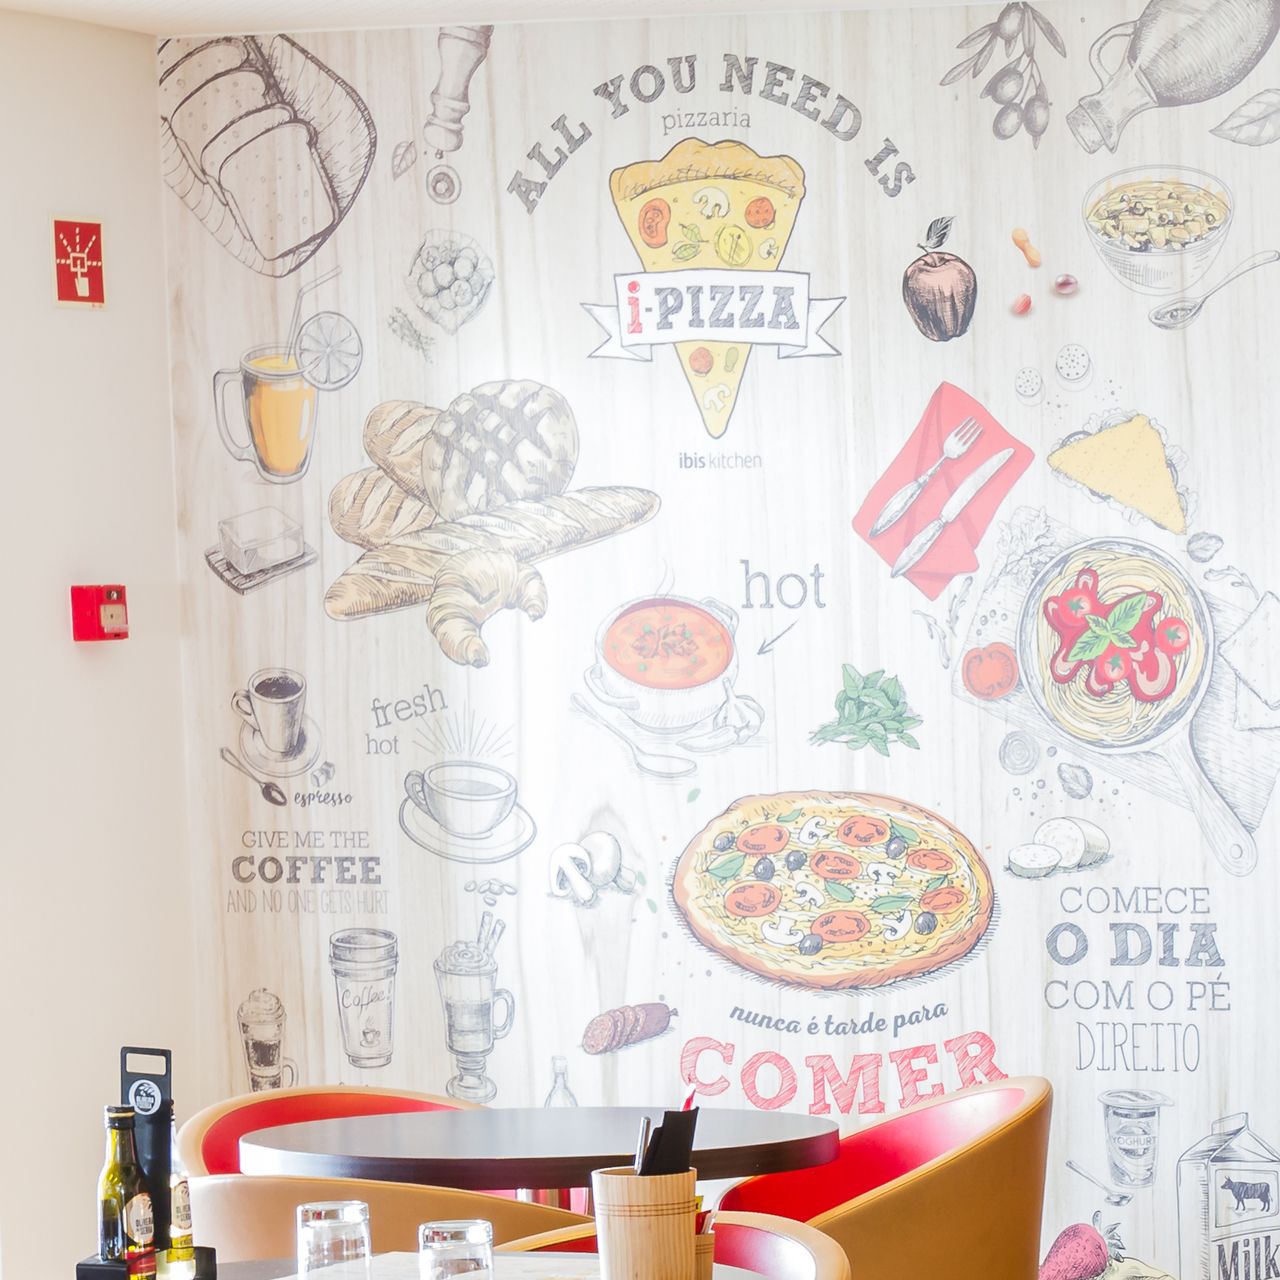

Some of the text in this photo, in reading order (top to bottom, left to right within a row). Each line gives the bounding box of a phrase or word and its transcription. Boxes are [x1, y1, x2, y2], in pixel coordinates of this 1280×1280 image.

[507, 53, 916, 215] ALL YOU NEED IS
[661, 106, 751, 136] pizzaria
[626, 280, 800, 335] i-PIZZA
[678, 452, 762, 469] ibis kitchen
[740, 559, 826, 608] hot
[371, 684, 448, 728] fresh
[366, 733, 399, 755] hot
[294, 790, 353, 807] espresso
[242, 831, 370, 848] GIVE ME THE
[231, 855, 381, 884] COFFEE
[227, 889, 390, 914] AND NO ONE GETS HURT
[1060, 886, 1210, 913] COMECE
[1045, 922, 1226, 967] O DIA
[1044, 971, 1231, 1011] COM O PÉ
[729, 1002, 948, 1038] nunca é tarde para
[1075, 1021, 1200, 1072] DIREITO
[680, 1031, 1009, 1115] COMER
[1111, 1135, 1157, 1146] YOGHURT
